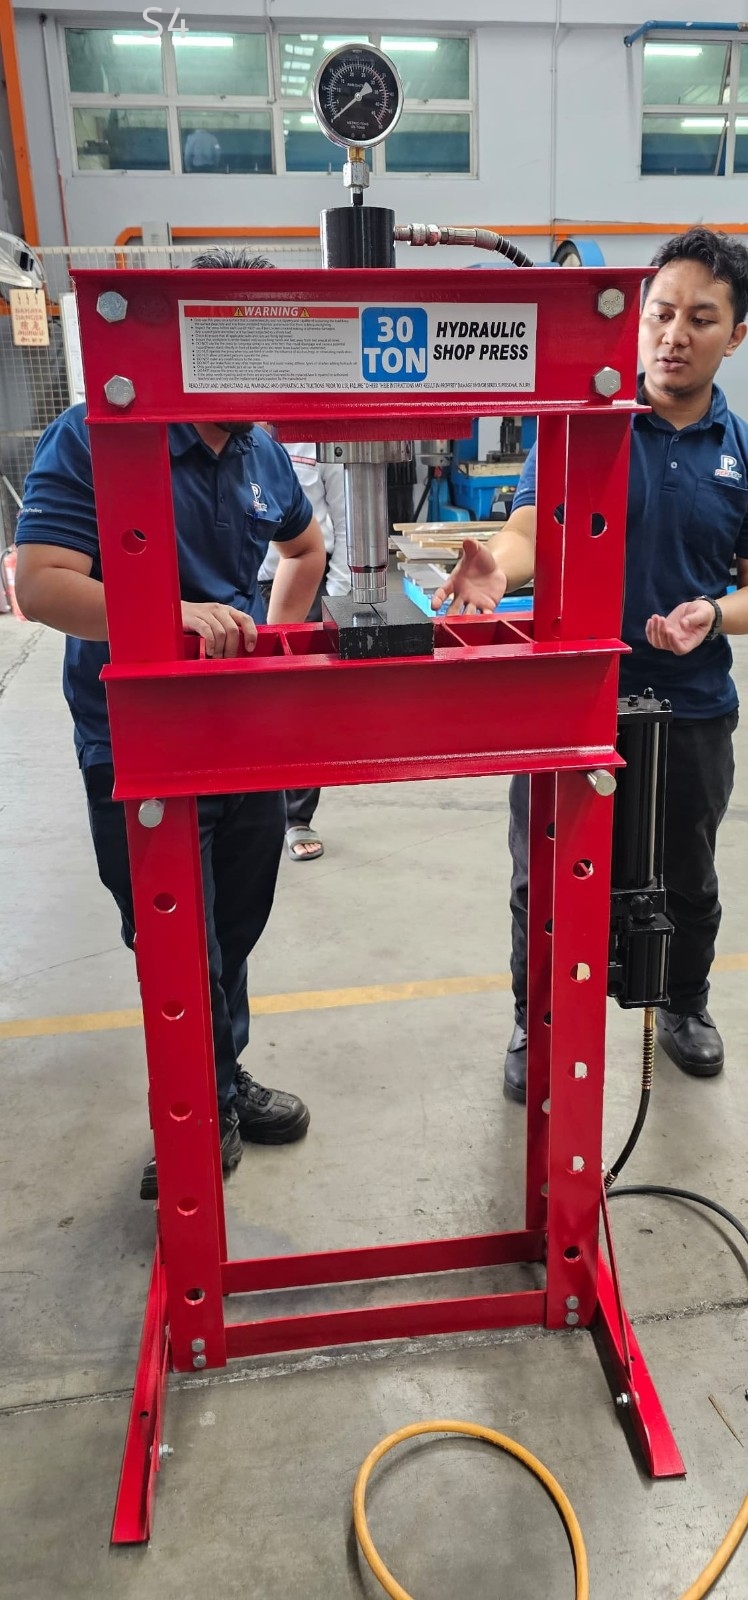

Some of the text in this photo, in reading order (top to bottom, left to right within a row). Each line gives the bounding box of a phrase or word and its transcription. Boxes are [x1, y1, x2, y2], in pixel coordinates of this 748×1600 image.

[244, 306, 299, 317] WARNING
[377, 315, 414, 343] 30
[435, 321, 526, 338] HYDRAULIC
[363, 347, 426, 374] TON
[433, 344, 529, 361] SHOP PRESS
